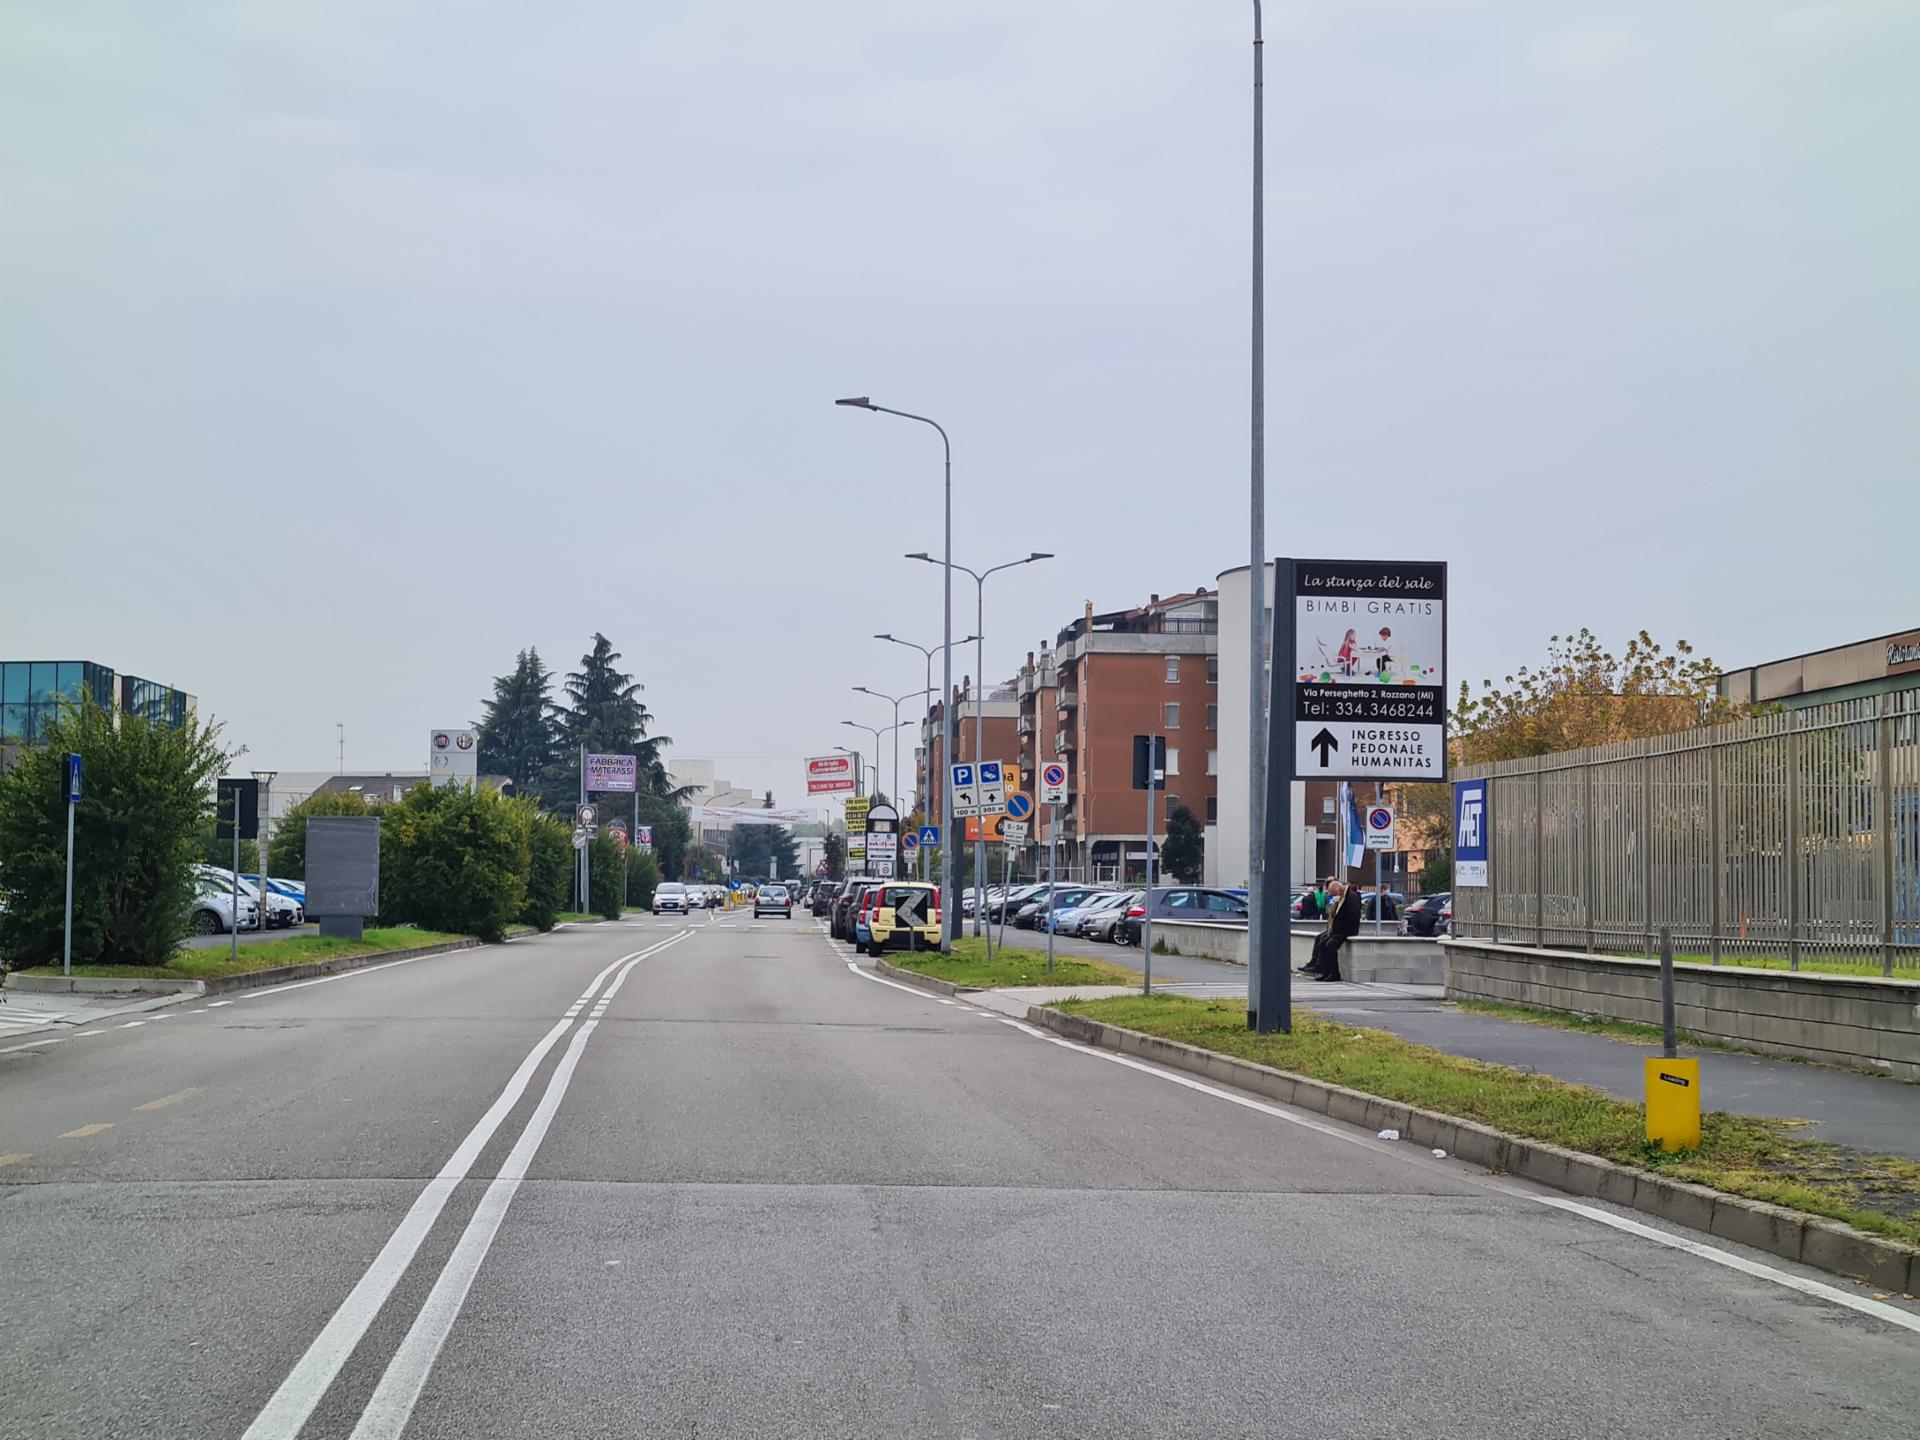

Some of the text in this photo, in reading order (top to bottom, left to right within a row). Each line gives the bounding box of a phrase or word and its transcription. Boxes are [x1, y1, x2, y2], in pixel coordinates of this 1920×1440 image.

[1304, 574, 1434, 591] La stanza del sale
[1306, 600, 1432, 615] BIMBI GRATIS
[1303, 689, 1318, 697] Via
[1320, 689, 1369, 699] Perseghetto
[1381, 690, 1416, 699] Rozzano
[1303, 701, 1433, 717] Tel: 334.3468244
[1352, 730, 1421, 741] INGRESSO
[1352, 743, 1423, 754] PEDONALE
[590, 758, 633, 766] FABBRICA
[1352, 756, 1432, 768] HUMANITAS
[591, 766, 634, 775] MATERASSI
